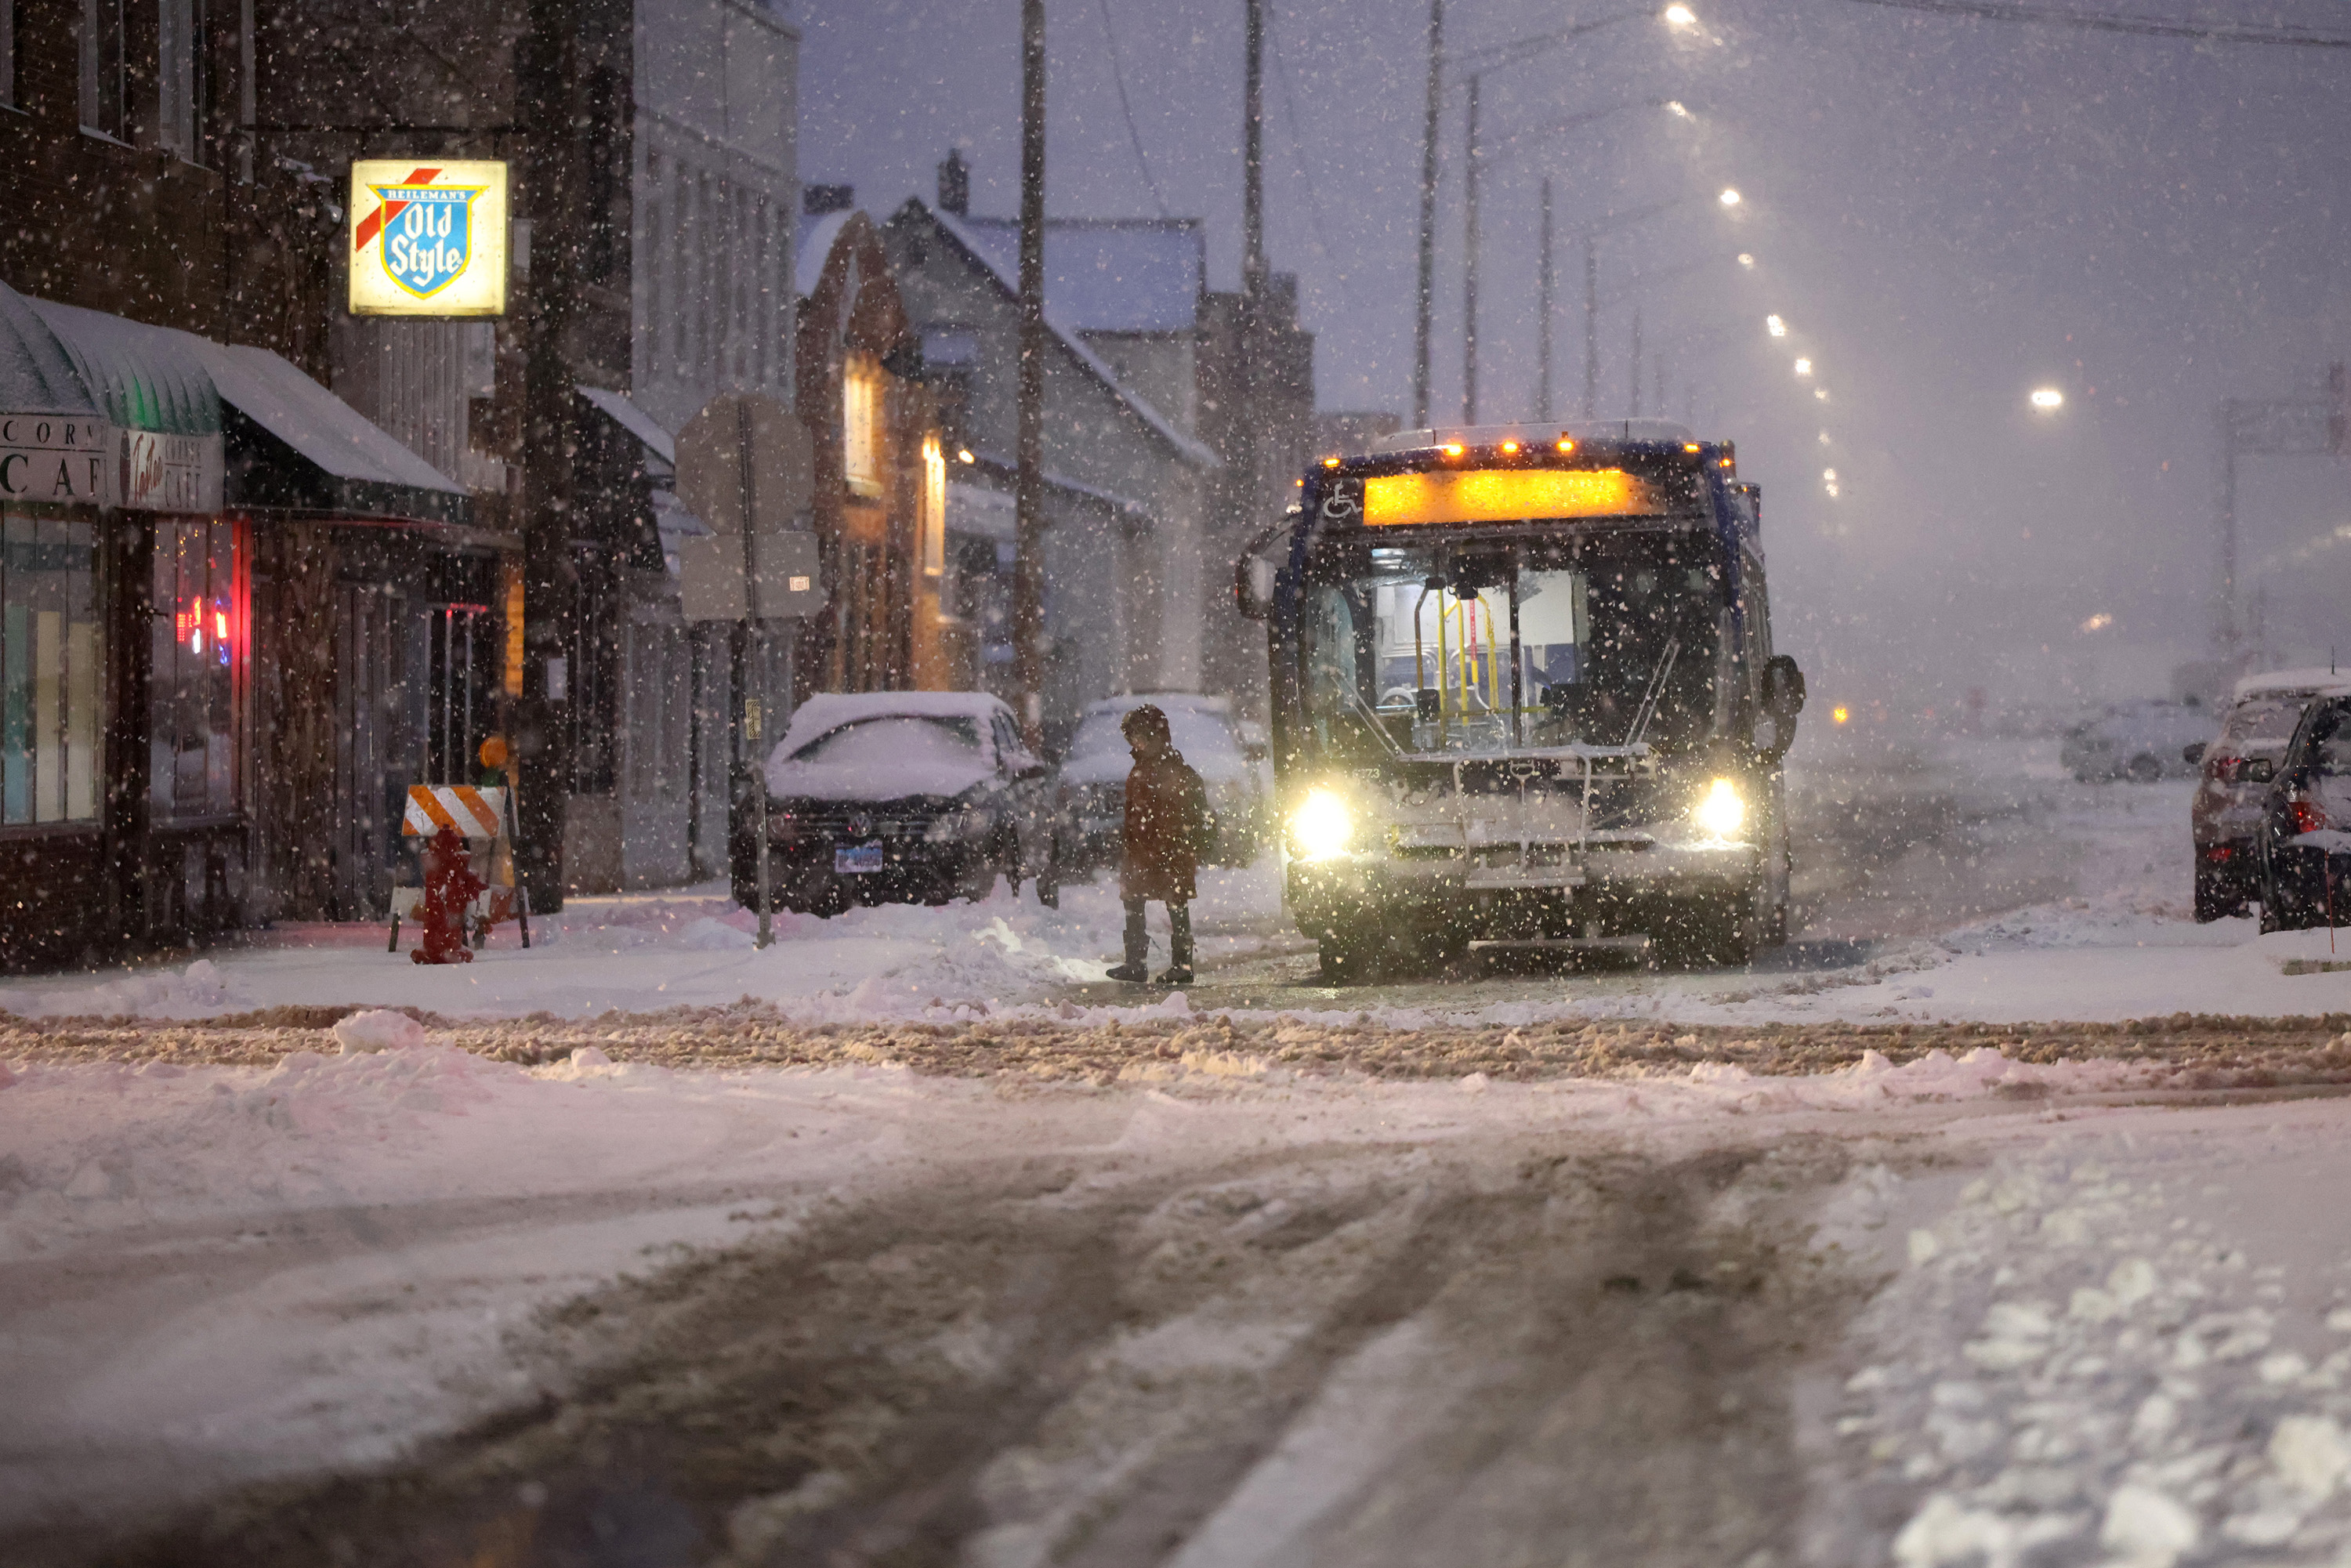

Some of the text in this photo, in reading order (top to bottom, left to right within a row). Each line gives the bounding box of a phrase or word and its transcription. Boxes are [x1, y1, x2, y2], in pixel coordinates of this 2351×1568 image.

[387, 190, 466, 200] HEILEMAN'S
[404, 202, 452, 240] Old
[389, 233, 461, 288] Style
